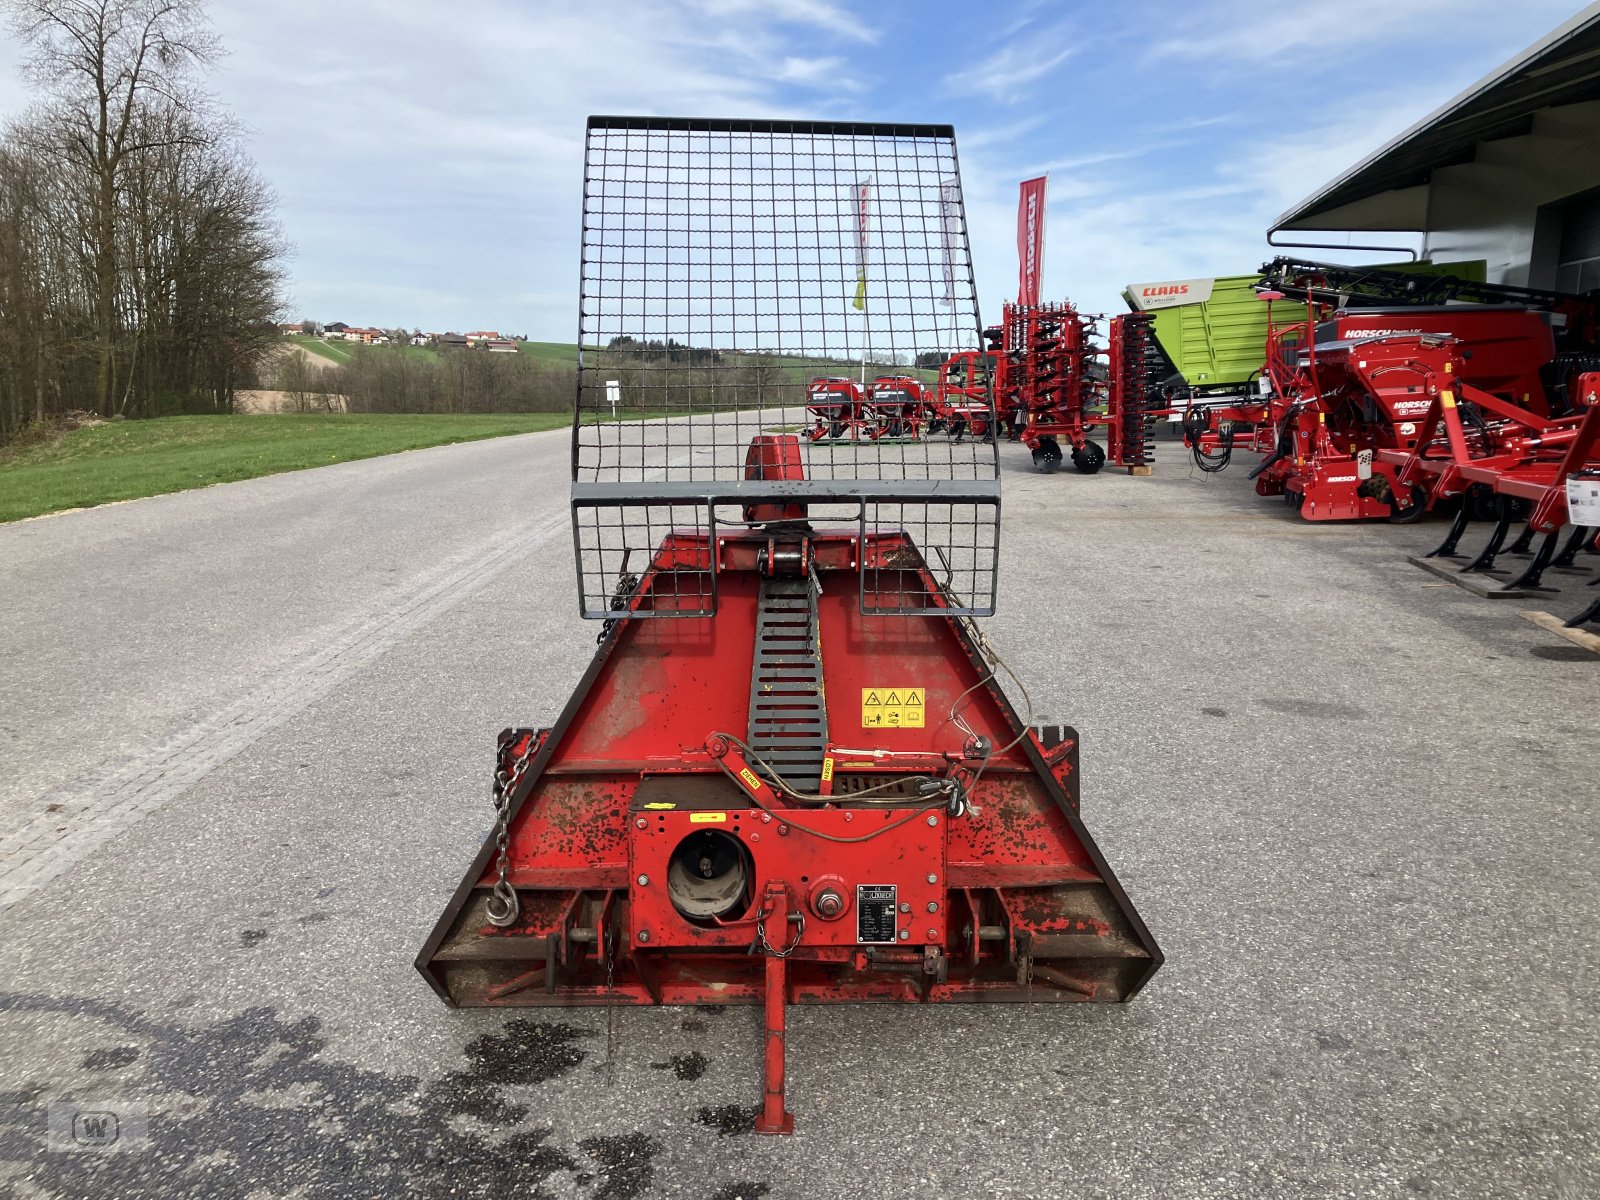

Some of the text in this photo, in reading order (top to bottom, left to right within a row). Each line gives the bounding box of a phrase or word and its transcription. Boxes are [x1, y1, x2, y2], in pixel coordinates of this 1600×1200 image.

[1143, 285, 1189, 297] CLAAS
[1344, 329, 1392, 338] HORSCH
[1393, 400, 1432, 409] HORSCH
